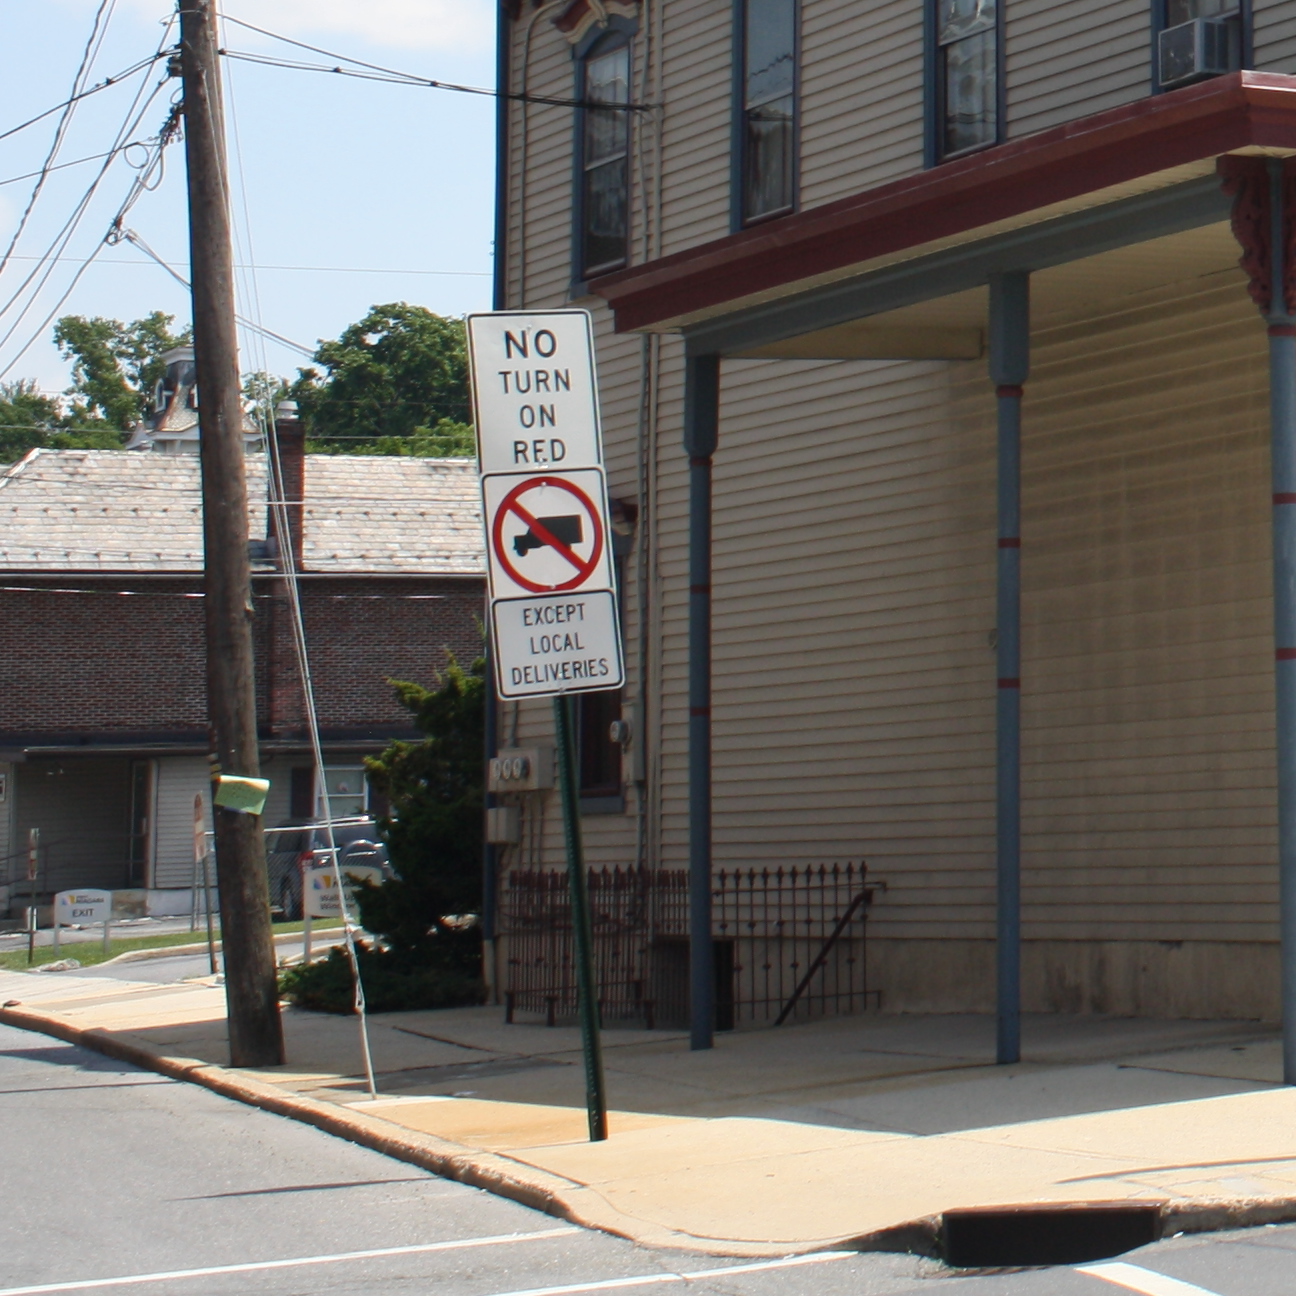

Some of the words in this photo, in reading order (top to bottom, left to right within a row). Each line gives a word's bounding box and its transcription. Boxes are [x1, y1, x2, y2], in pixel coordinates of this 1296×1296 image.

[504, 329, 557, 359] NO
[498, 368, 570, 394] TURN
[520, 403, 556, 428] ON
[513, 438, 567, 464] RED
[523, 602, 586, 626] EXCEPT
[530, 632, 585, 655] LOCAL
[511, 657, 609, 685] DELIVERIES
[71, 908, 94, 917] EXIT
